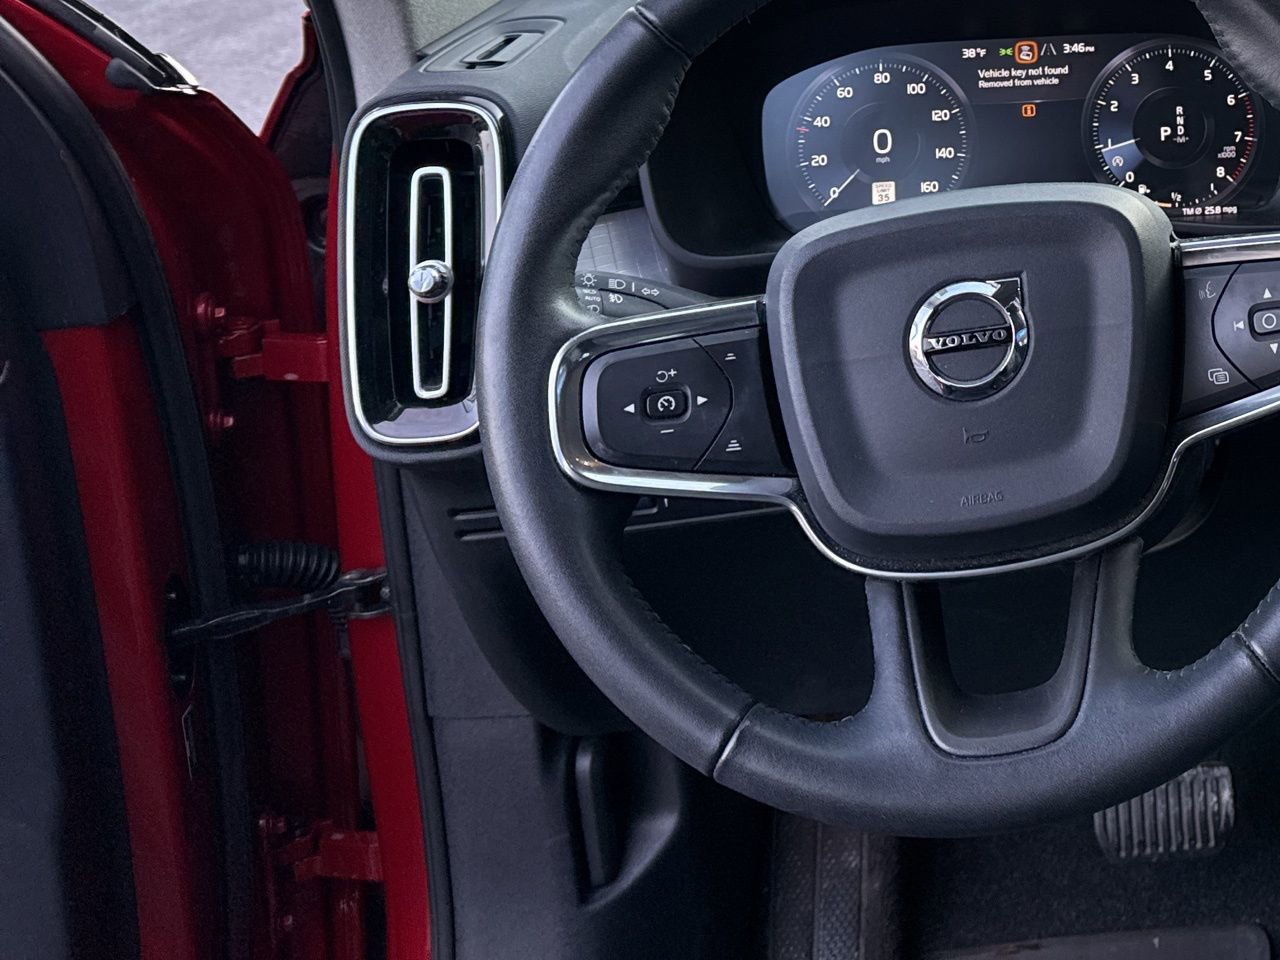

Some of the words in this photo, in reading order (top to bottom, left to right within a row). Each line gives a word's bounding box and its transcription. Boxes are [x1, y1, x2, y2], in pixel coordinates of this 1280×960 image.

[1165, 61, 1174, 71] 4
[978, 68, 1010, 79] Vehicle
[1011, 68, 1027, 79] key
[1028, 66, 1043, 76] not
[1044, 65, 1069, 75] found
[1204, 70, 1212, 81] 5
[873, 72, 891, 84] 80
[978, 79, 1013, 88] Removed
[1014, 78, 1032, 86] from
[1033, 77, 1059, 85] vehicle
[1131, 73, 1139, 85] 3
[836, 87, 853, 98] 60
[906, 83, 926, 94] 100
[1226, 94, 1236, 106] 6
[1110, 101, 1119, 112] 2
[1176, 106, 1184, 115] R
[931, 110, 950, 121] 120
[1176, 116, 1184, 125] N
[813, 116, 831, 127] 40
[1160, 127, 1172, 141] P
[1177, 126, 1185, 135] D
[872, 128, 893, 154] 0
[1234, 131, 1242, 143] 7
[935, 147, 955, 159] 140
[811, 154, 828, 166] 20
[875, 156, 890, 164] mph
[1125, 171, 1134, 182] 0
[1216, 166, 1225, 178] 8
[829, 187, 840, 198] 0
[920, 181, 939, 193] 160
[877, 193, 890, 202] 35
[1182, 207, 1194, 216] TM
[1204, 206, 1221, 215] 25.8
[1222, 206, 1238, 214] mpg
[927, 329, 1008, 351] VOLVO
[960, 490, 1004, 508] AIRBAG
